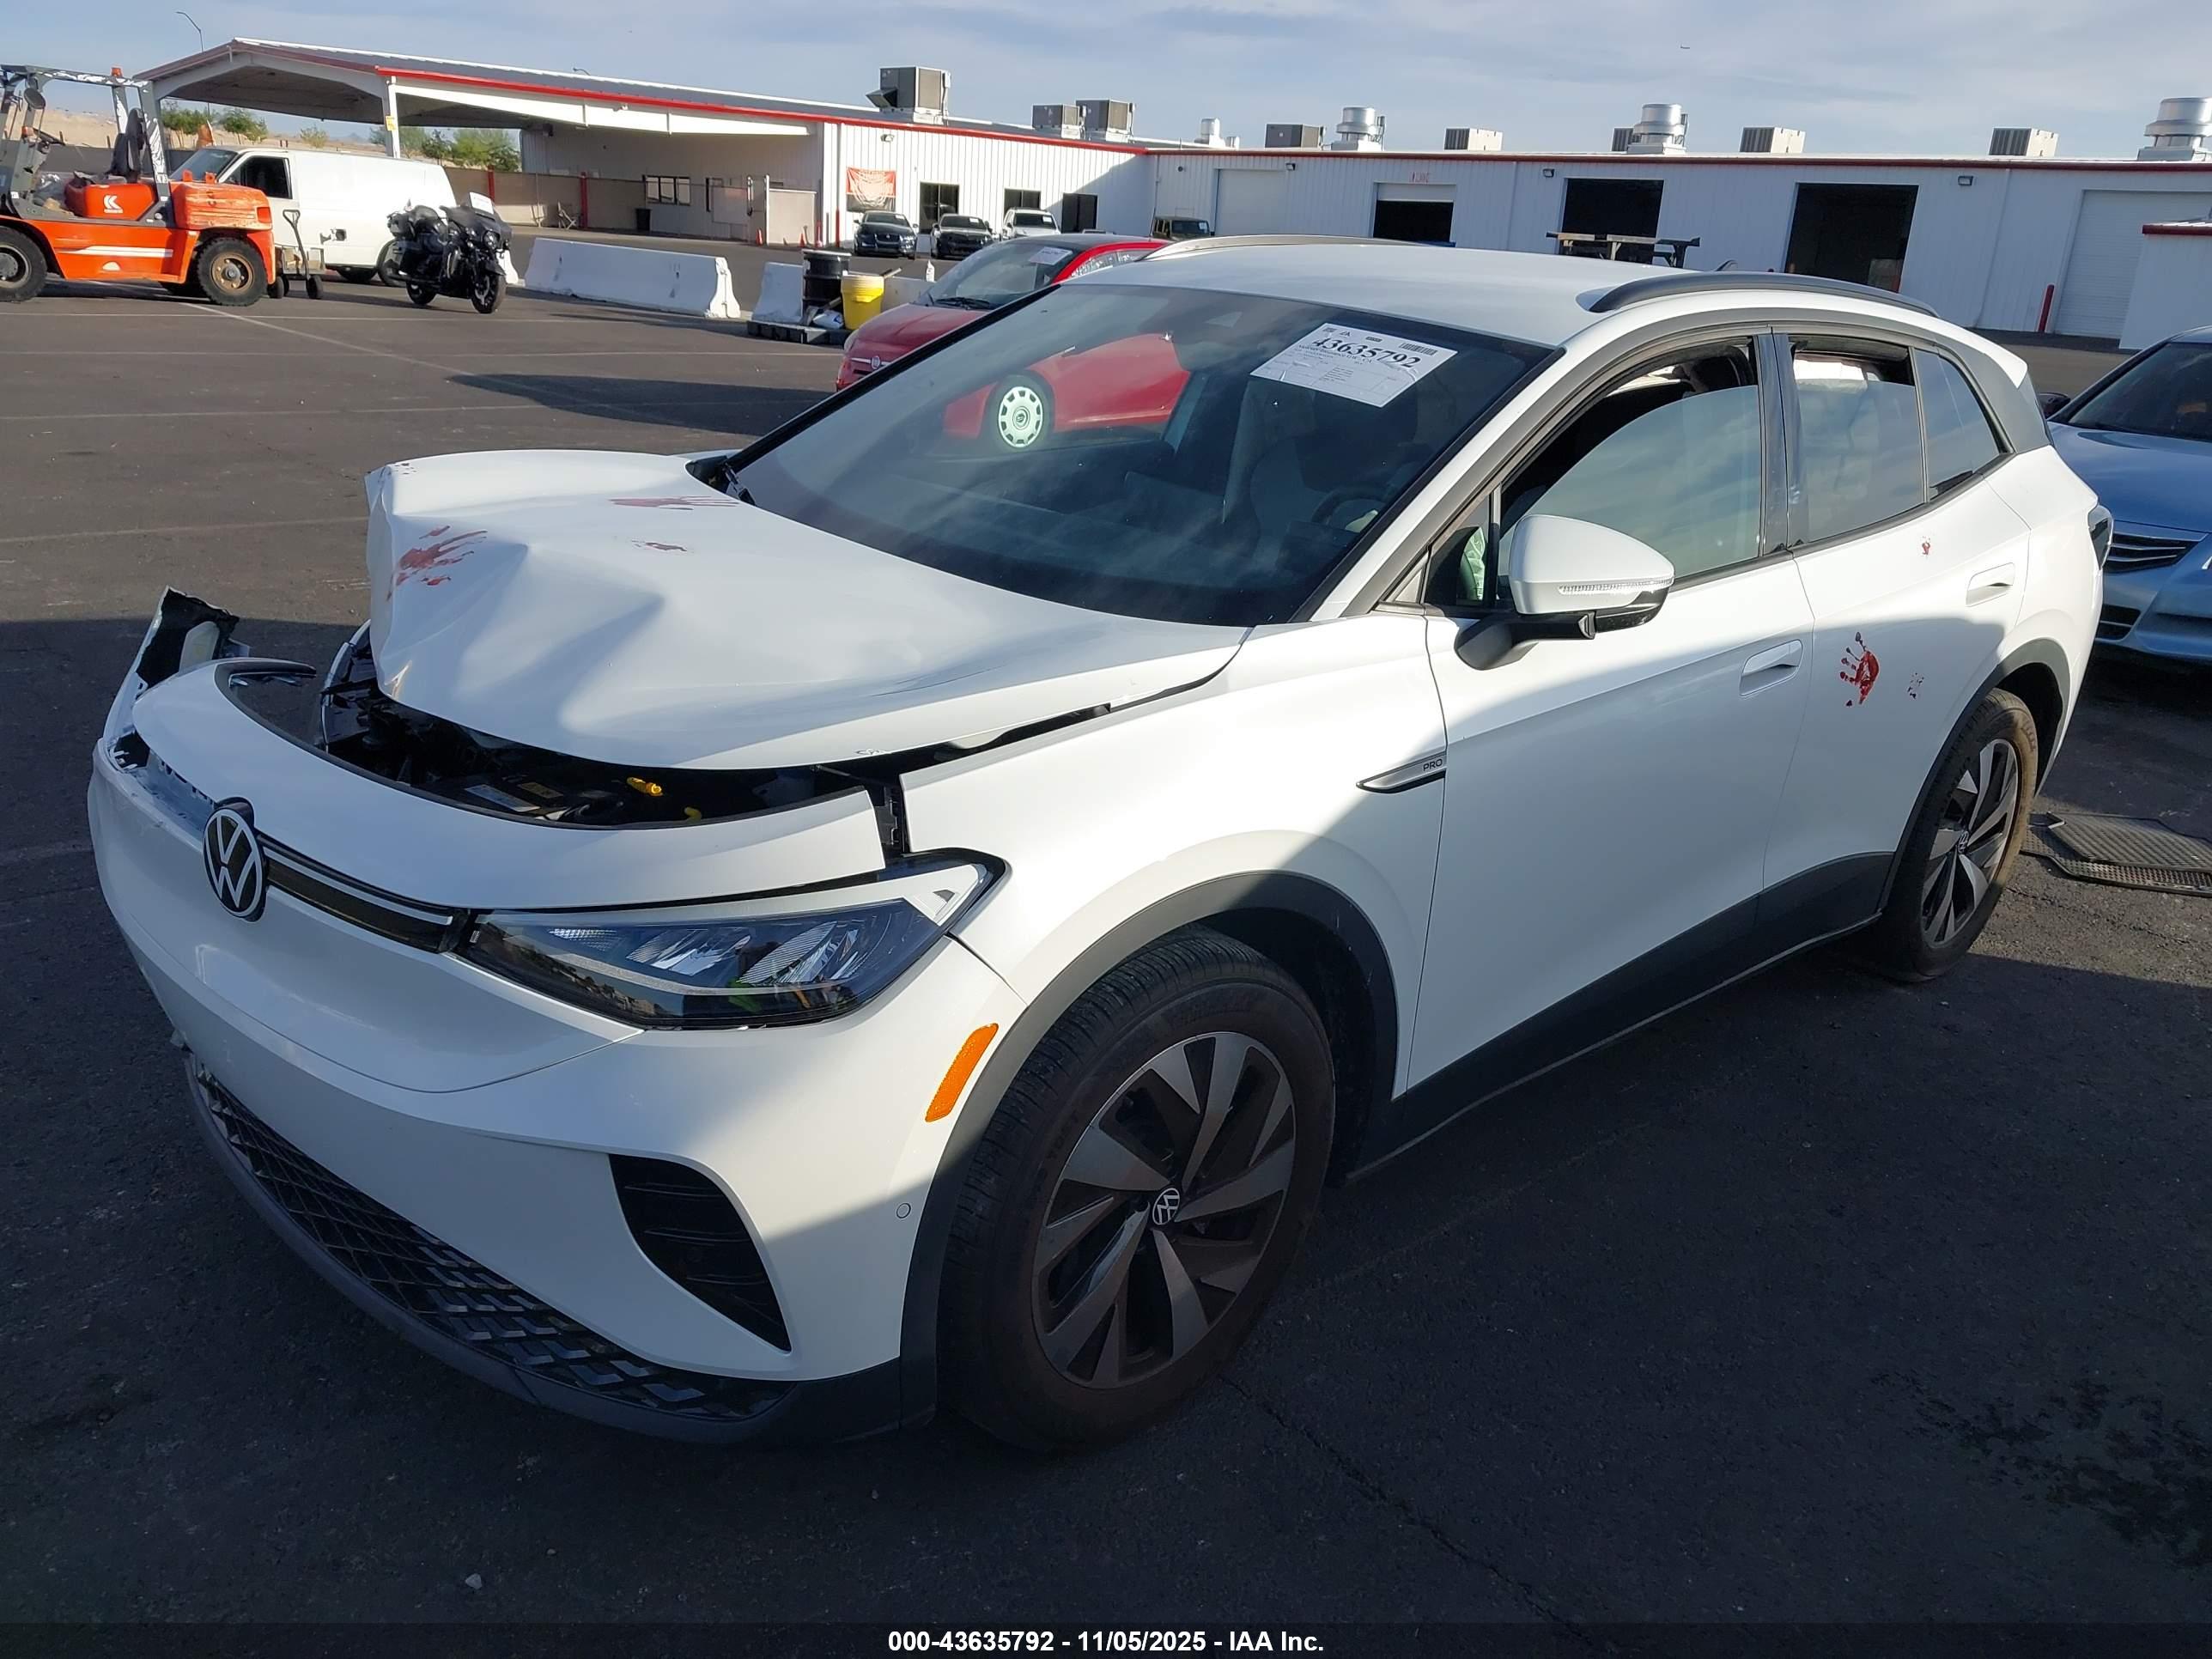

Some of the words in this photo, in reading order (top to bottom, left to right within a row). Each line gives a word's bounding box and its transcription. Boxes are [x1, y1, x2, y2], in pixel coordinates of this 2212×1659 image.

[1312, 337, 1421, 368] 43635792
[1423, 758, 1443, 772] PRO
[204, 809, 263, 917] VW
